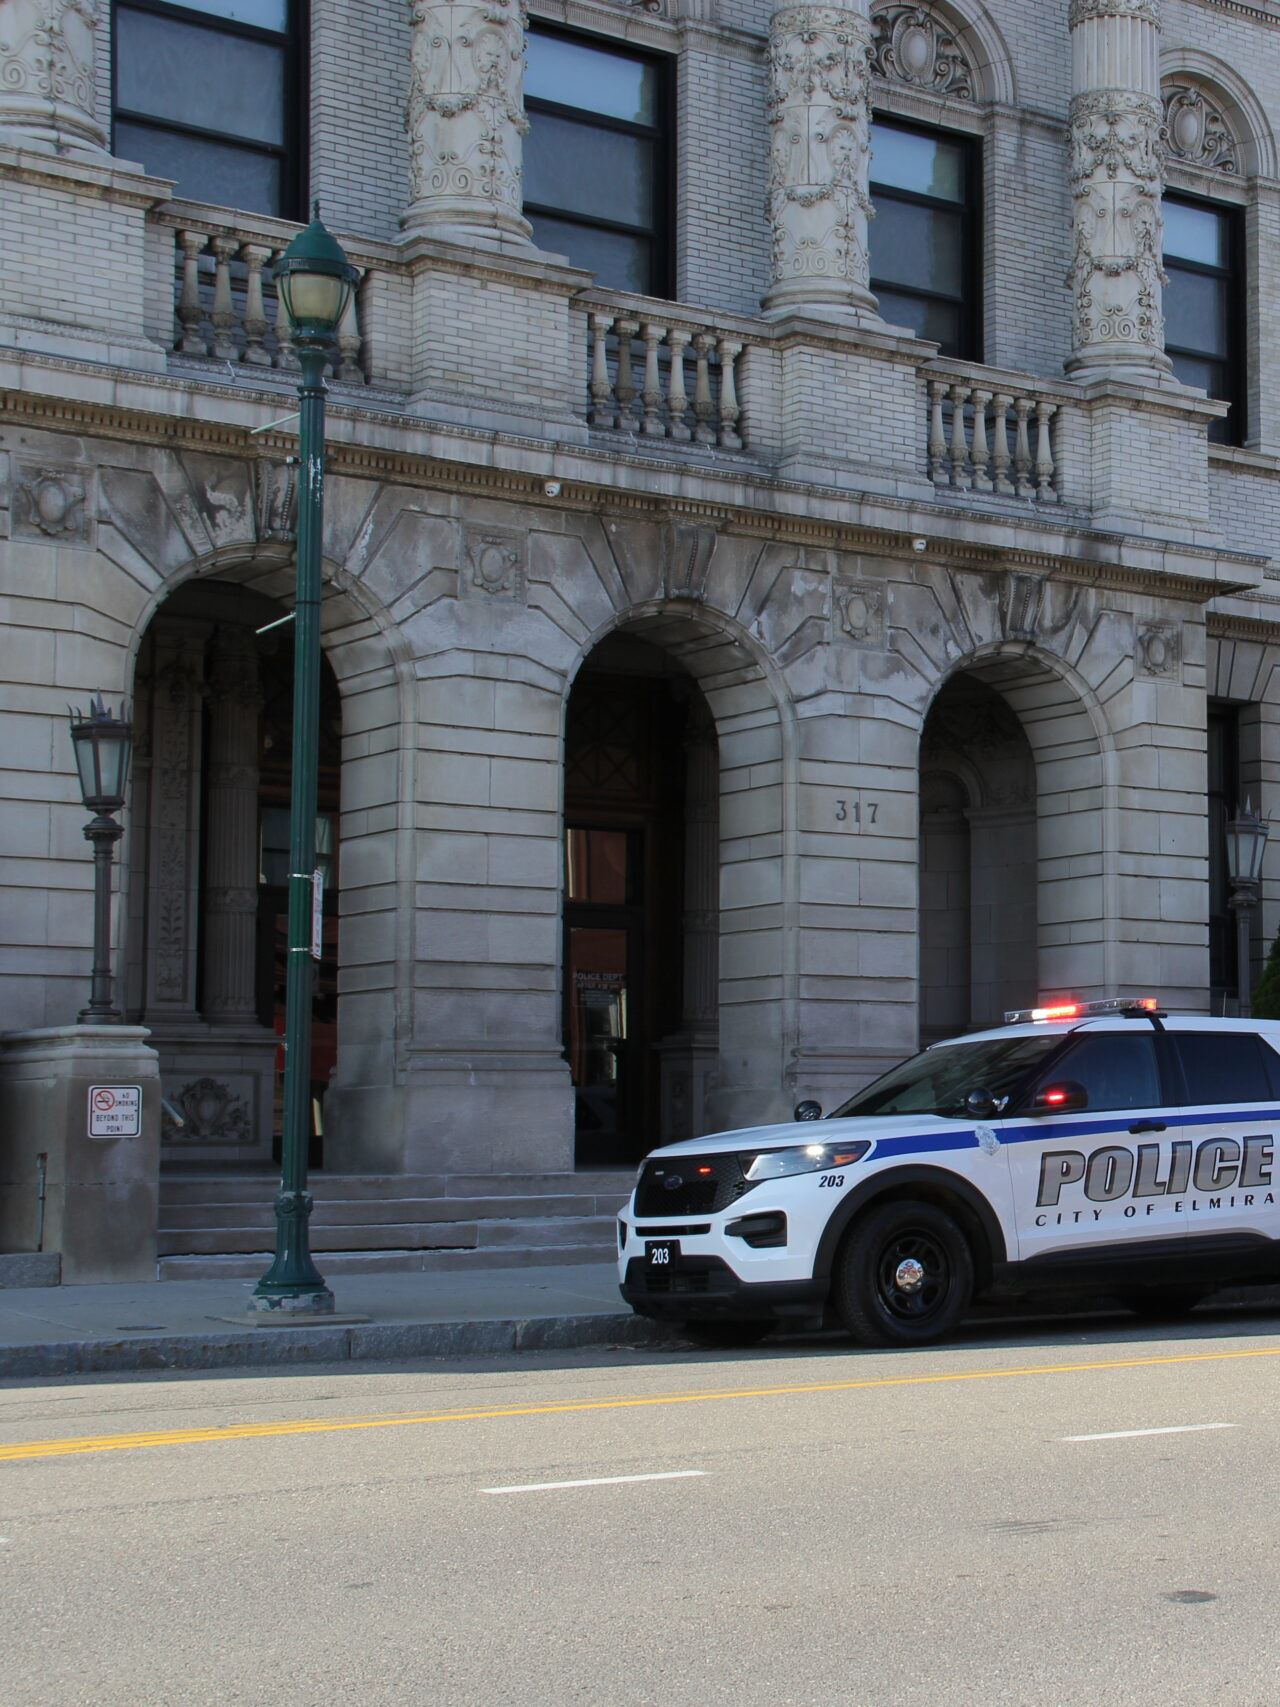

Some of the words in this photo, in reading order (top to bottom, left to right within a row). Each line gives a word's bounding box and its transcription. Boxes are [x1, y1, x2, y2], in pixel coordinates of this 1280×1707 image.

[835, 800, 879, 824] 317
[96, 1114, 119, 1122] BEYOND
[122, 1114, 135, 1122] THIS
[1036, 1134, 1274, 1207] POLICE
[818, 1175, 845, 1188] 203
[1036, 1209, 1103, 1227] CITY
[1124, 1203, 1155, 1218] OF
[1174, 1193, 1275, 1212] ELMIRA
[651, 1248, 670, 1265] 203
